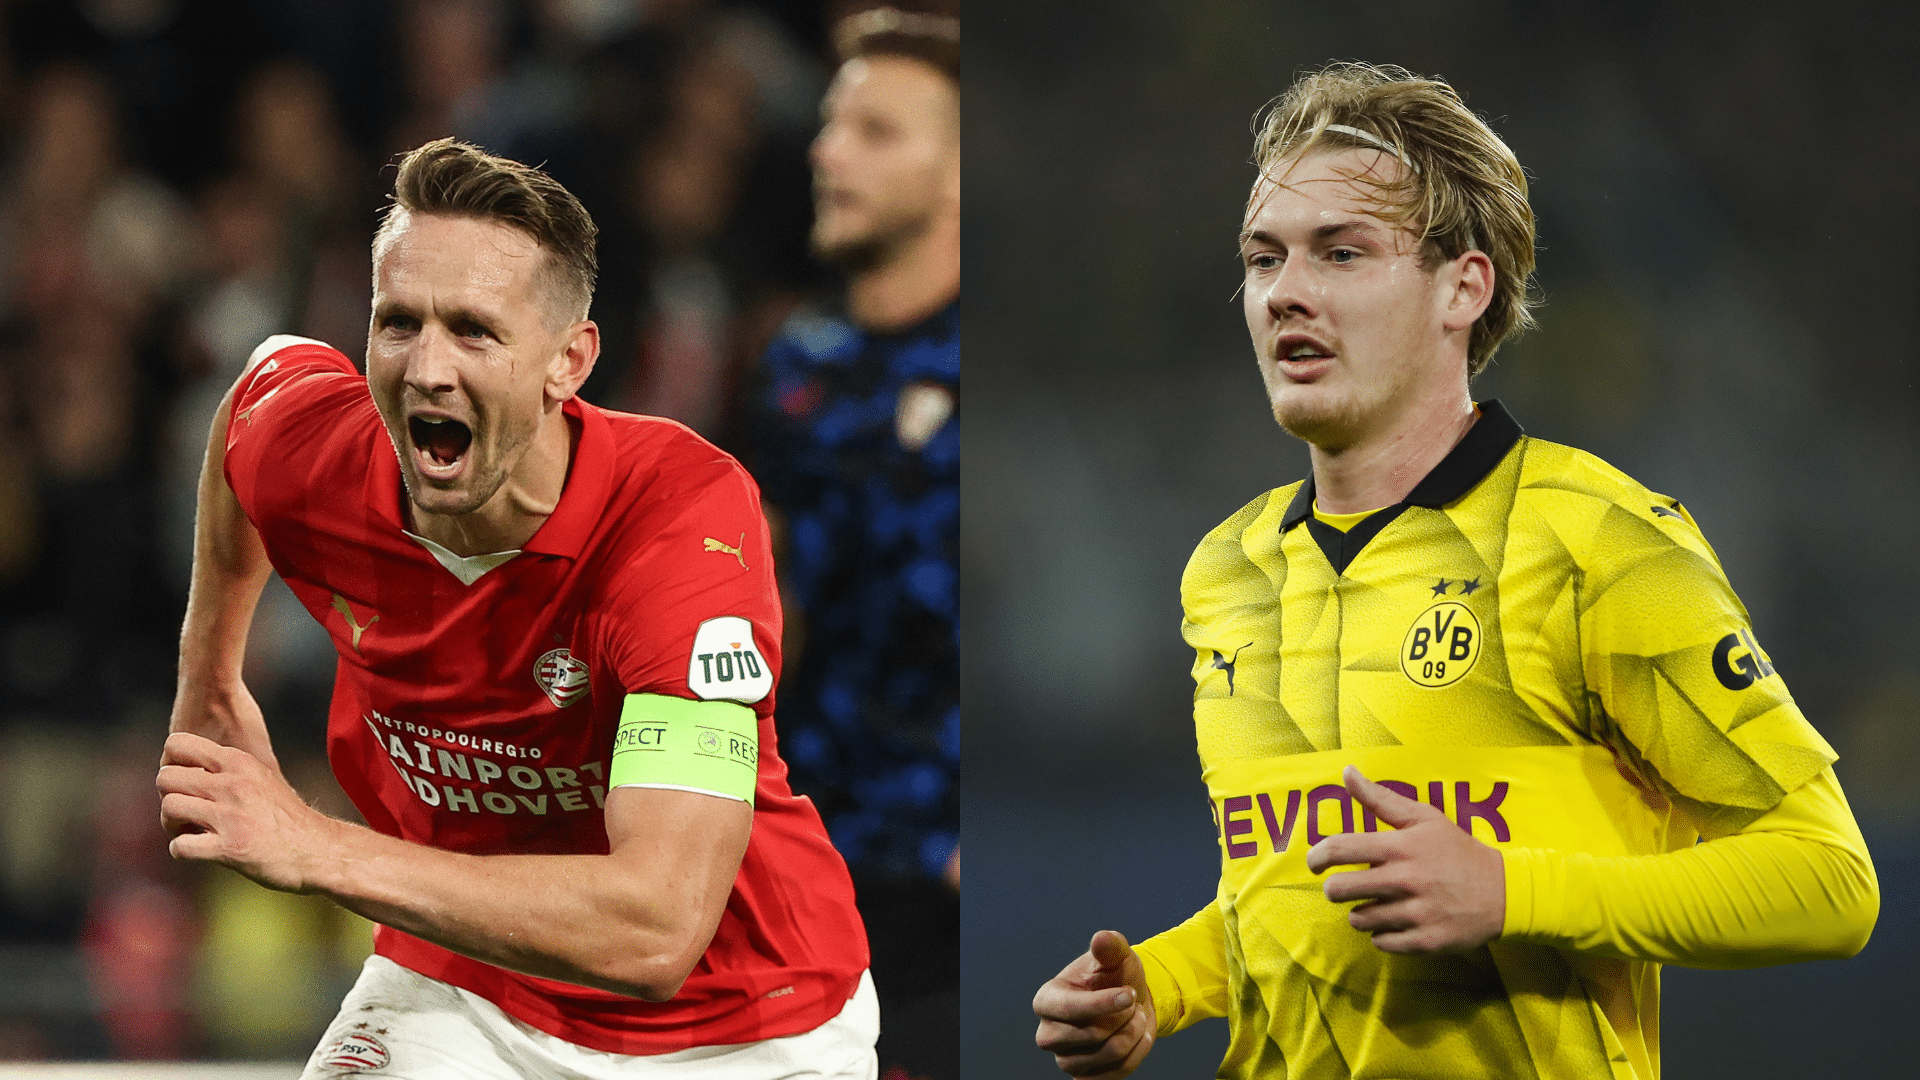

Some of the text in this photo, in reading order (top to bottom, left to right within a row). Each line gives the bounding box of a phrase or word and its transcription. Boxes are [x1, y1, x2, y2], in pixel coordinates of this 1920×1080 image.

[1409, 609, 1472, 661] BVB
[697, 650, 761, 684] TOTO
[1422, 661, 1446, 679] 09
[372, 709, 541, 759] METROPOOLREGIO
